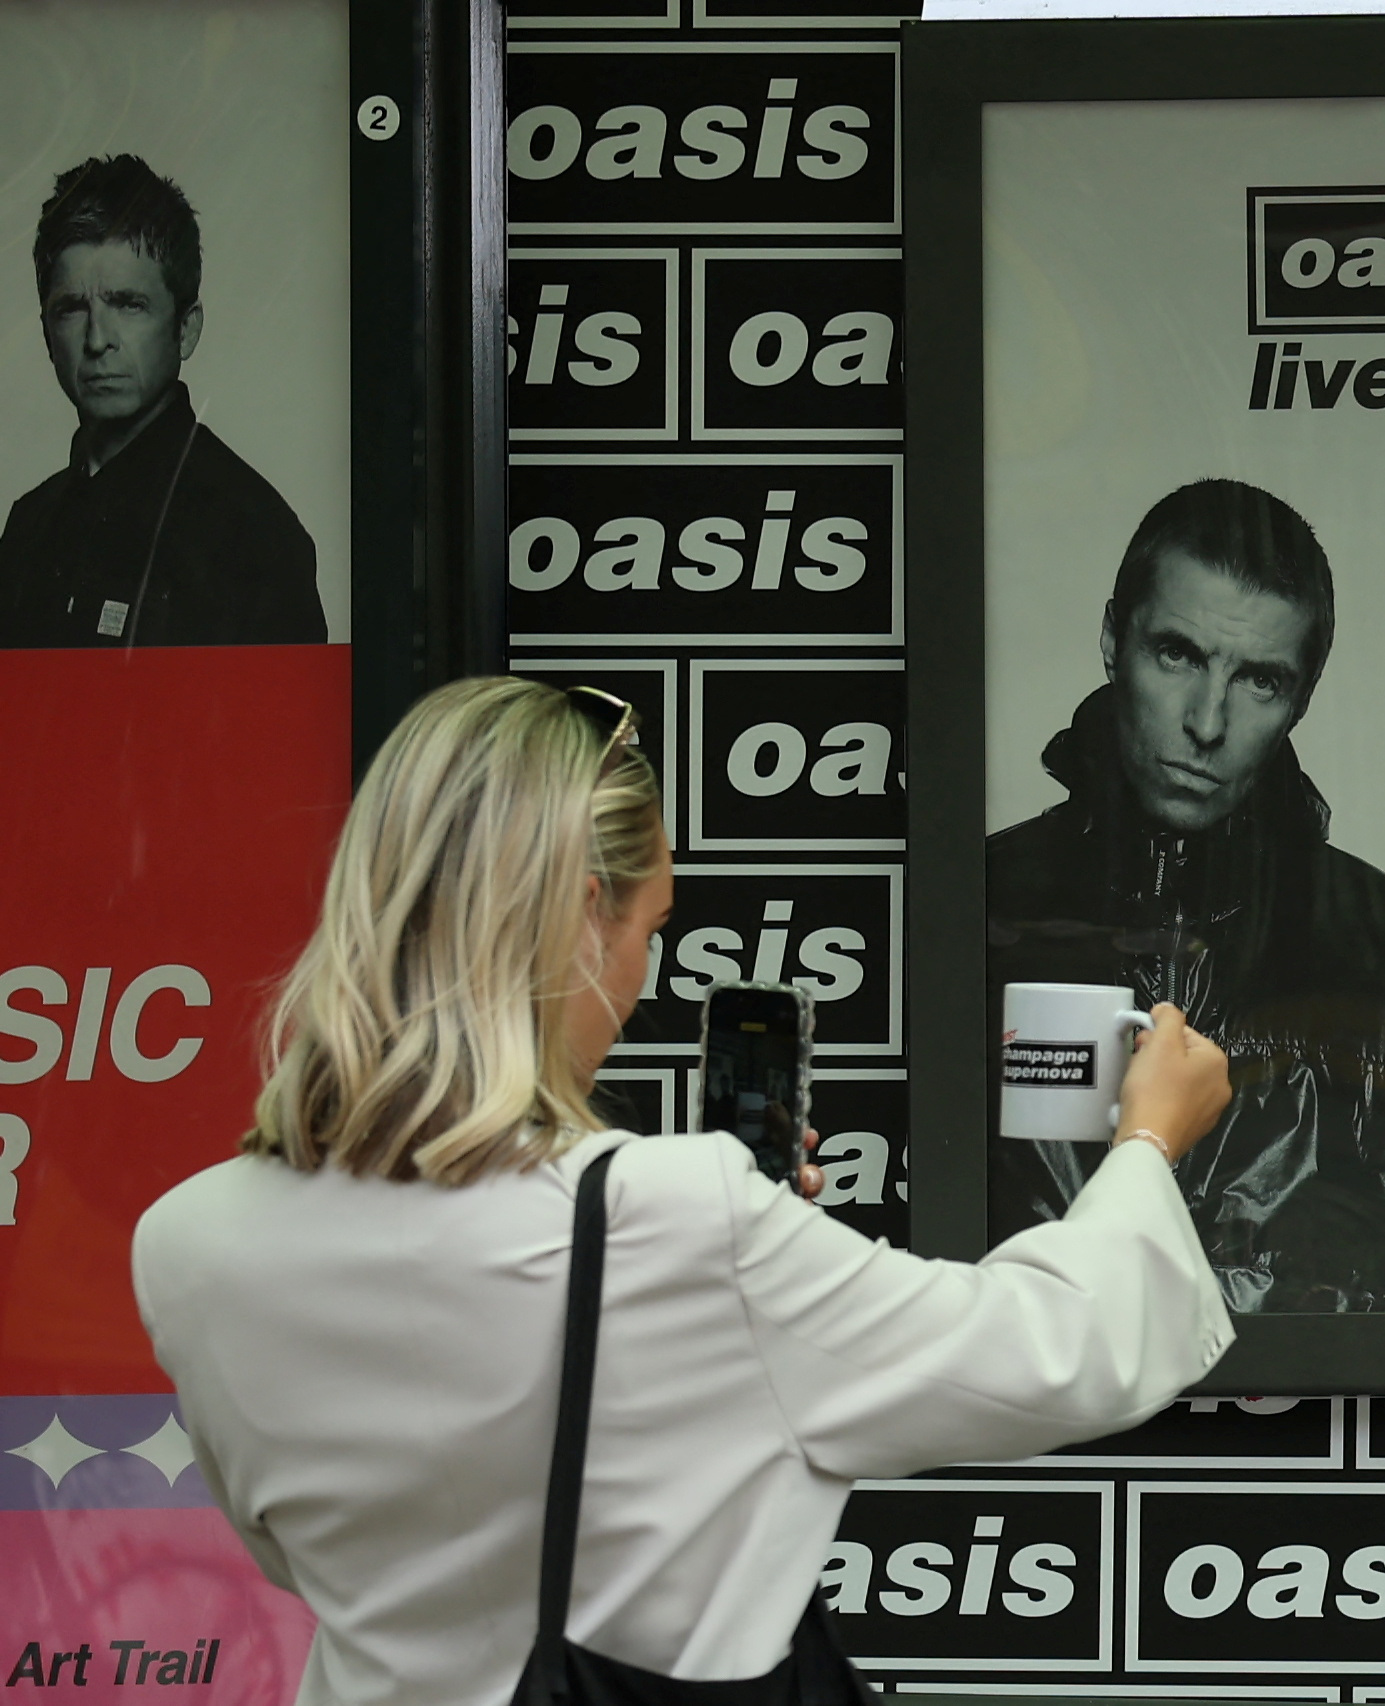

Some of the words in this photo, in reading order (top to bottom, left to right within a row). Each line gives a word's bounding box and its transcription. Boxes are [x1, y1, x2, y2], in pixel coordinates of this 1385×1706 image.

[370, 106, 387, 130] 2
[508, 79, 869, 180] oasis
[508, 285, 641, 386] is
[730, 312, 904, 387] oa
[508, 491, 868, 592] oasis
[727, 723, 906, 797] oa
[637, 900, 867, 1002] sis
[6, 1642, 92, 1687] Art
[110, 1639, 221, 1686] Trail
